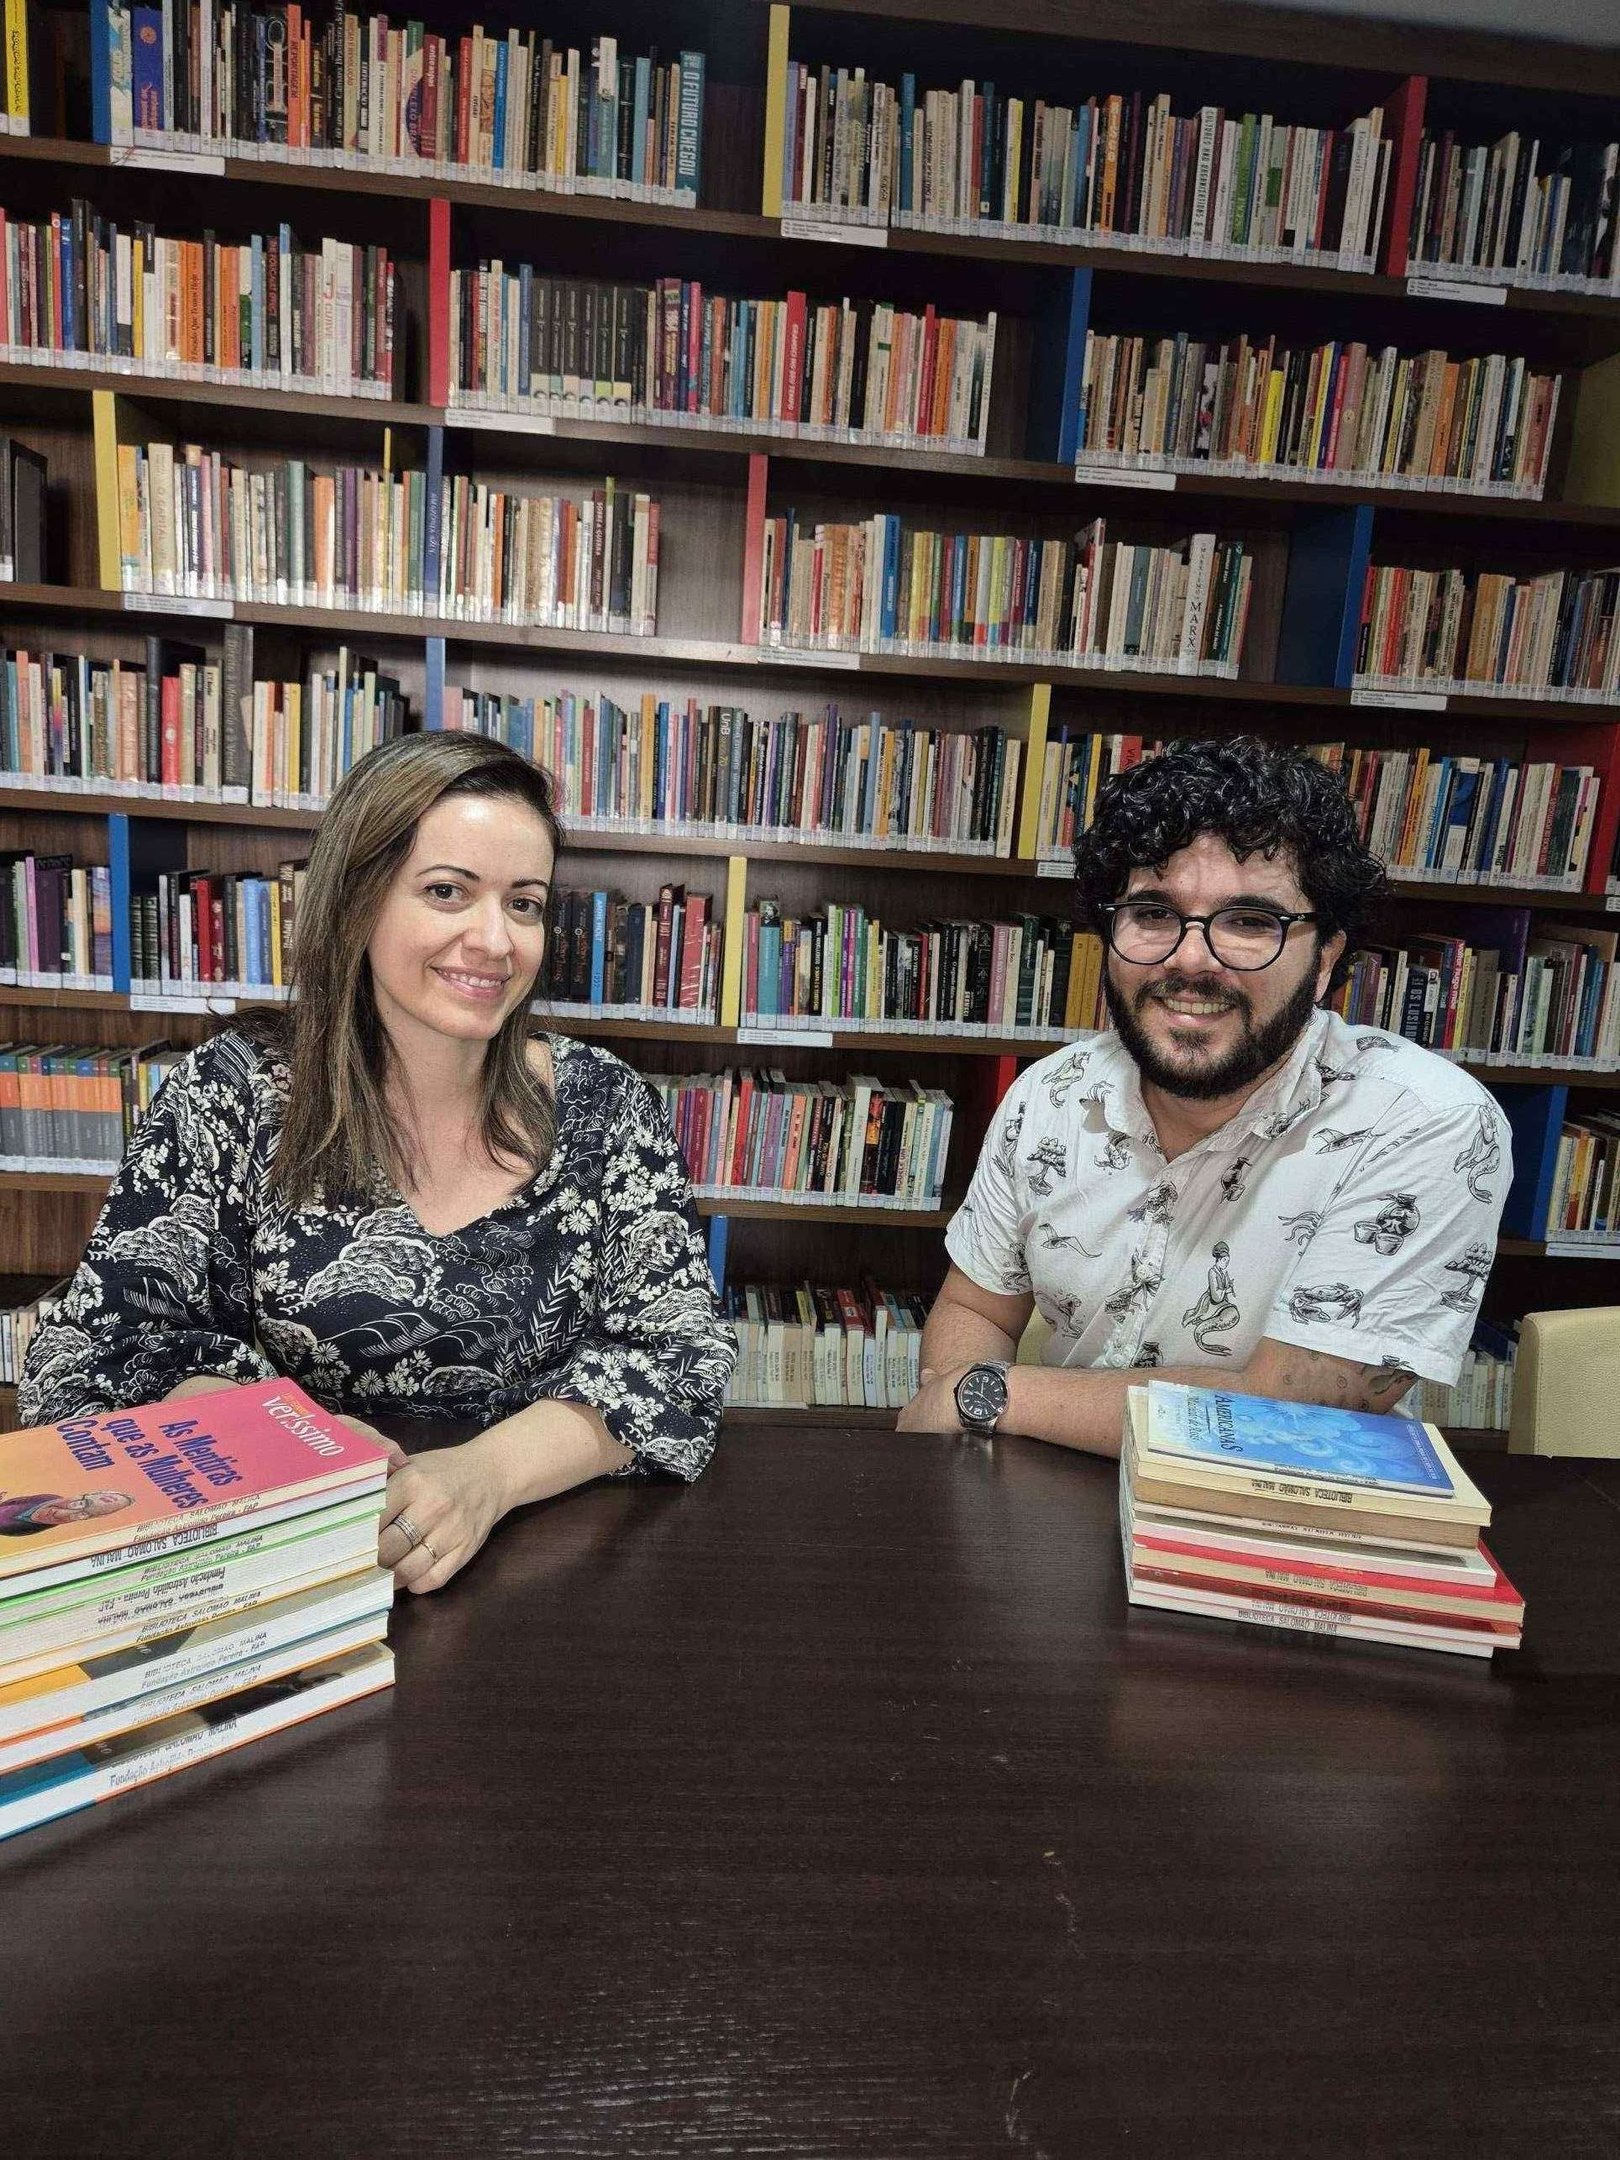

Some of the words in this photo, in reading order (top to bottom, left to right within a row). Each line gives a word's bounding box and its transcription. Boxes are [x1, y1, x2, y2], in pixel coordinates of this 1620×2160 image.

[684, 71, 701, 80] O
[682, 82, 700, 126] FUTURO
[679, 129, 699, 176] CHEGOU
[721, 713, 731, 736] UnB
[595, 922, 604, 942] HOLT
[1451, 967, 1461, 990] hugo
[104, 1417, 142, 1446] que
[158, 1418, 198, 1440] As
[1214, 1394, 1244, 1453] AMERICANAS
[56, 1418, 117, 1472] Contam
[128, 1437, 158, 1460] as
[177, 1430, 244, 1488] Mentiras
[137, 1453, 210, 1510] Mulheres
[1250, 1478, 1277, 1491] MALINA
[1315, 1488, 1354, 1504] BIBLIOTECA
[172, 1522, 218, 1547] BIBLIOTECA
[90, 1551, 122, 1568] MALINA
